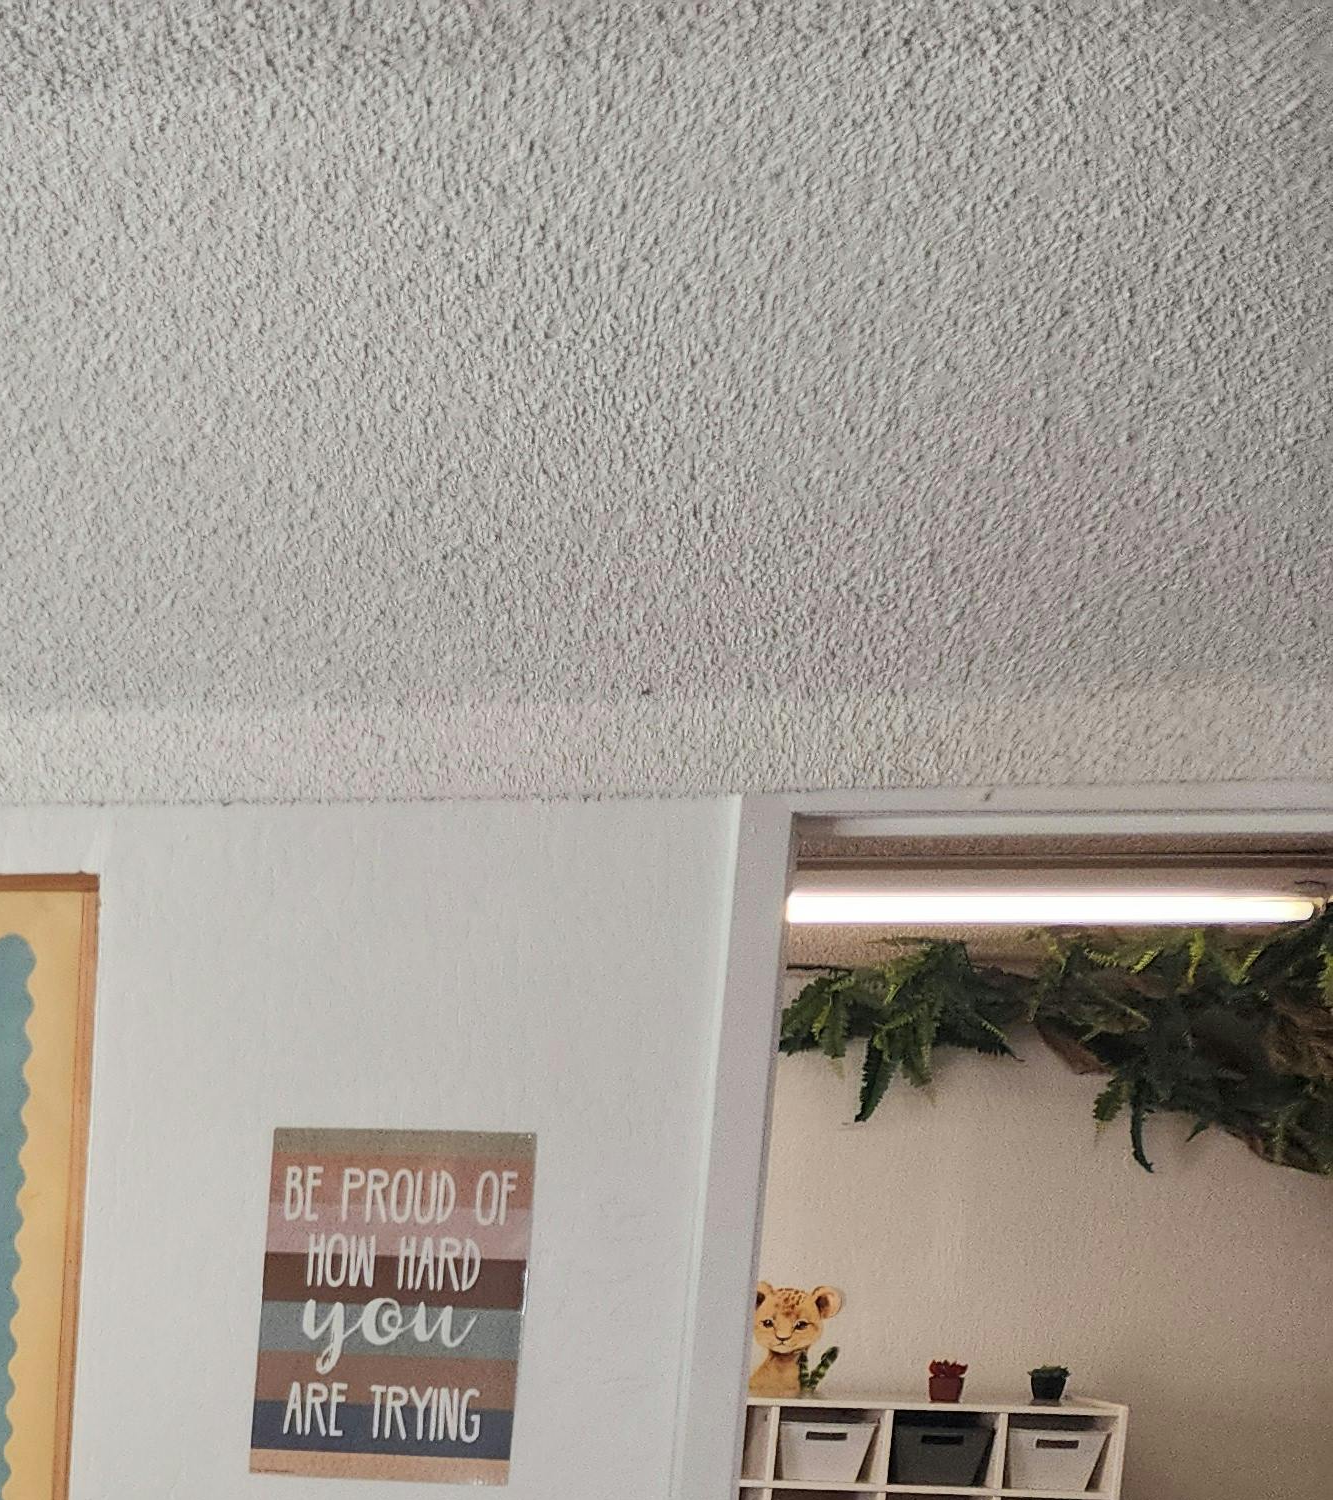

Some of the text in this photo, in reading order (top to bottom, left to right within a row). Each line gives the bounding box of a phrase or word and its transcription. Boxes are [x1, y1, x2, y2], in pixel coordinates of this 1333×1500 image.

[284, 1165, 518, 1226] BE PROUD OF
[306, 1233, 482, 1291] HOW HARD
[302, 1297, 477, 1374] you
[283, 1382, 481, 1443] ARE TRYING
